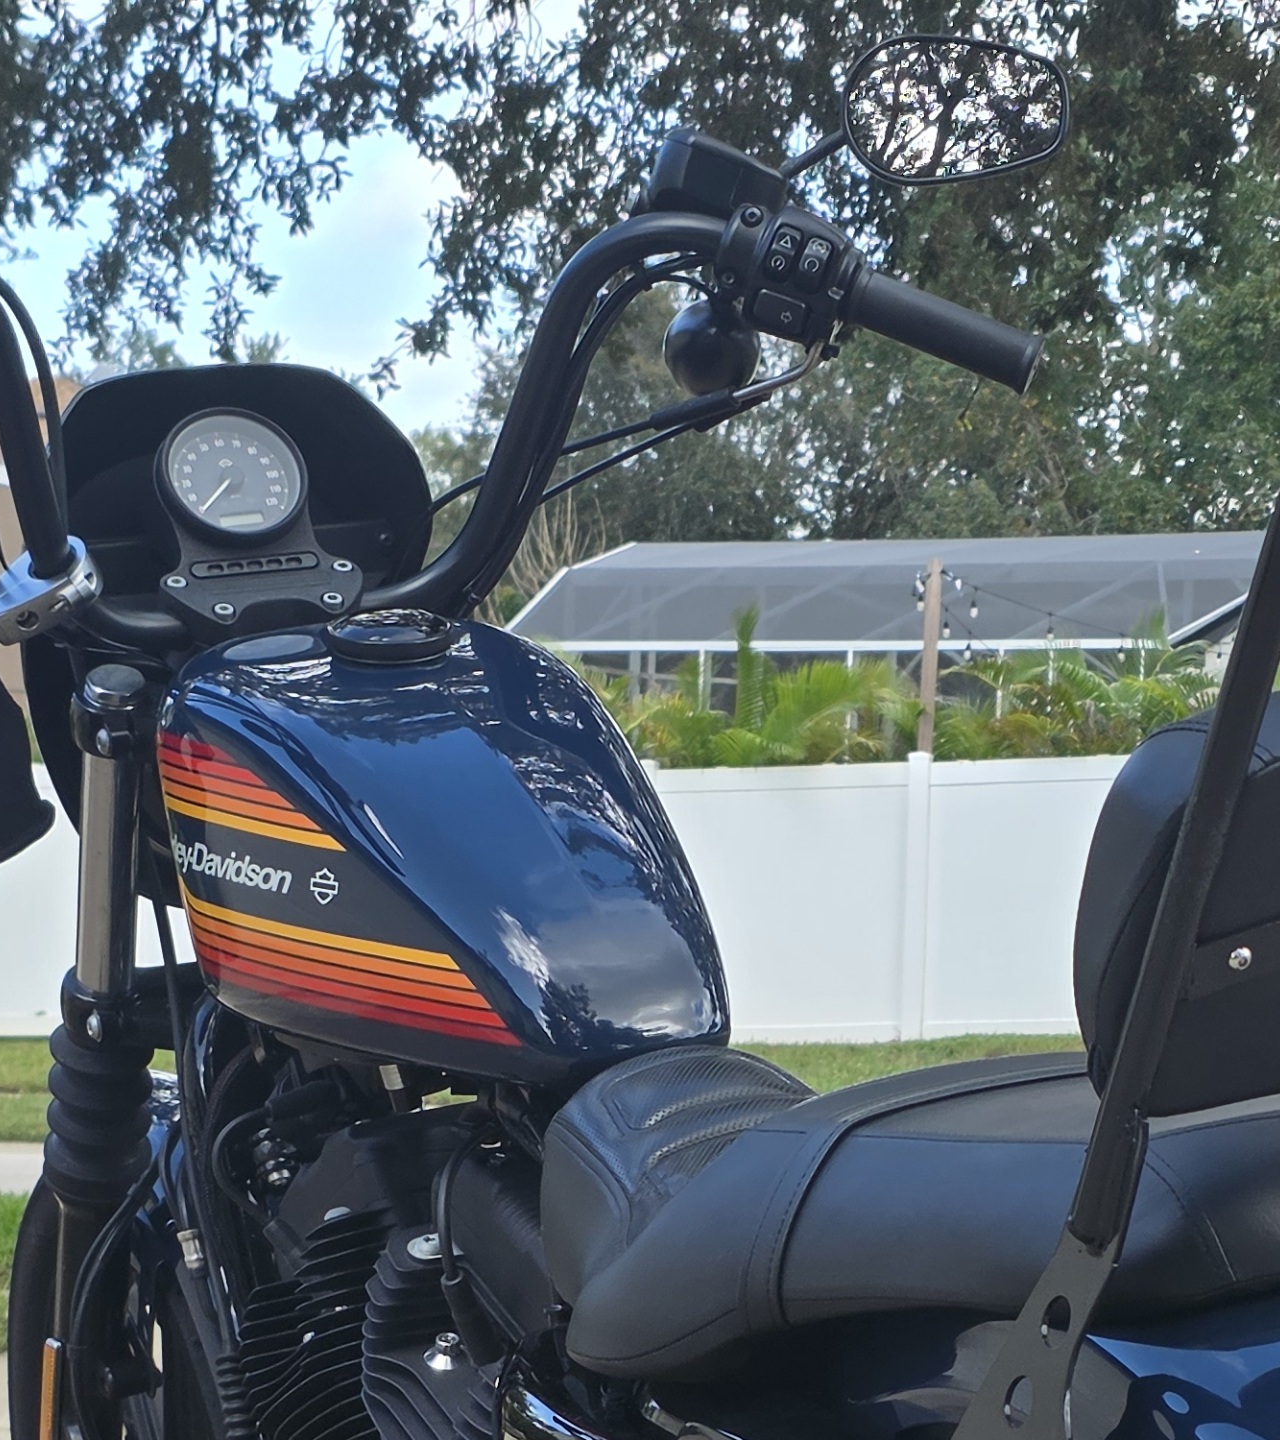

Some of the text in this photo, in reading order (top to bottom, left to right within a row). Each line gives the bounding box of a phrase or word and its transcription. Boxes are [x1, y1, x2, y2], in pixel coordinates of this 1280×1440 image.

[215, 439, 224, 447] 60
[232, 440, 241, 448] 70
[266, 470, 279, 479] 100
[265, 497, 278, 506] 120
